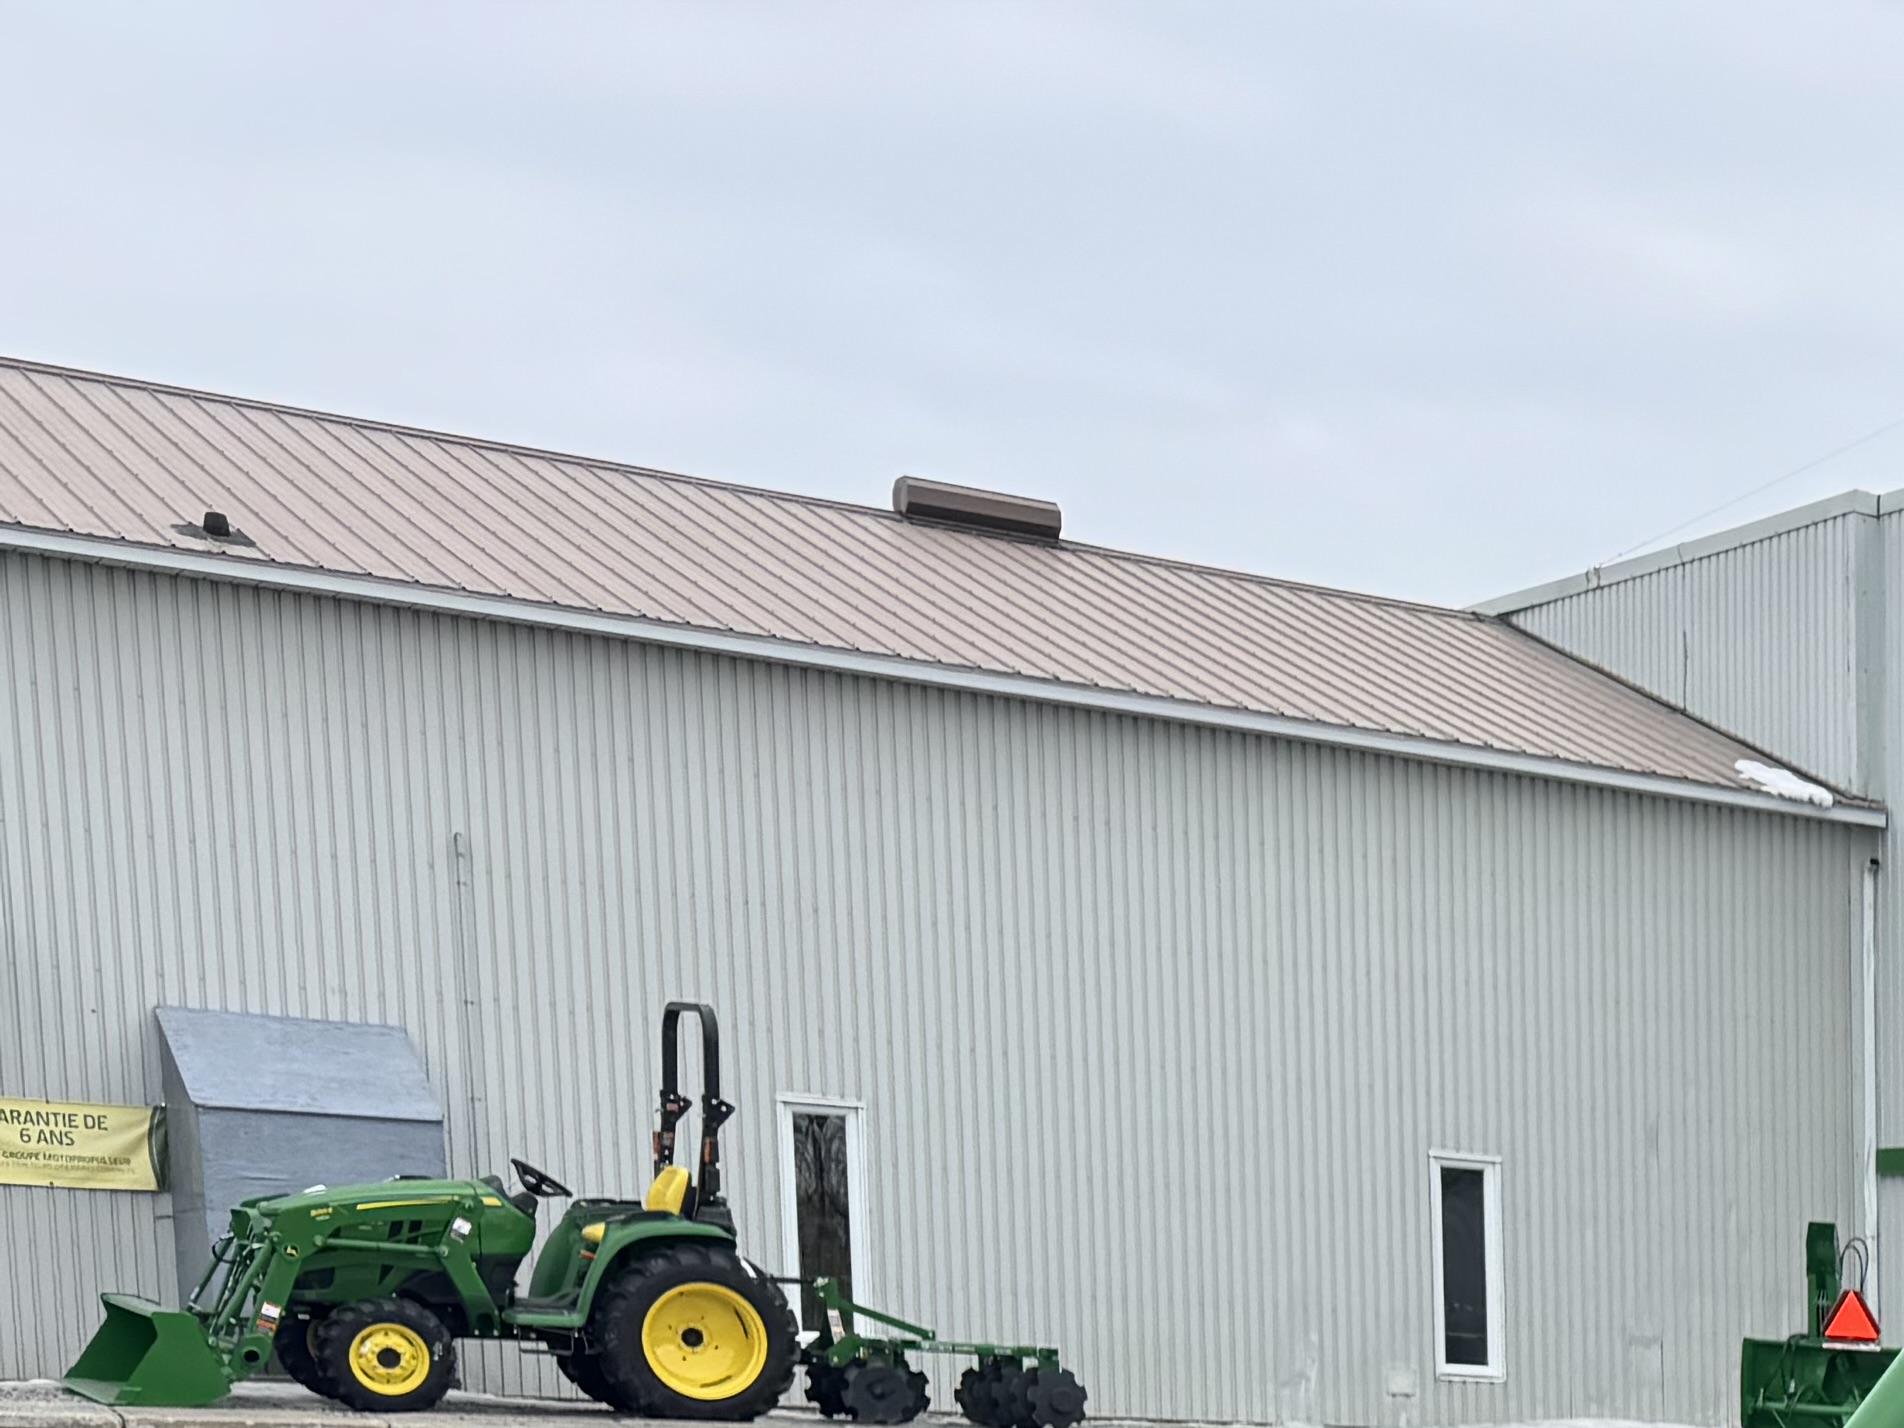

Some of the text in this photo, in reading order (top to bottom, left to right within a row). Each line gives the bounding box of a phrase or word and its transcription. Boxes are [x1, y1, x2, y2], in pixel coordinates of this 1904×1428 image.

[83, 1113, 109, 1131] DE
[19, 1127, 75, 1147] 6 ANS
